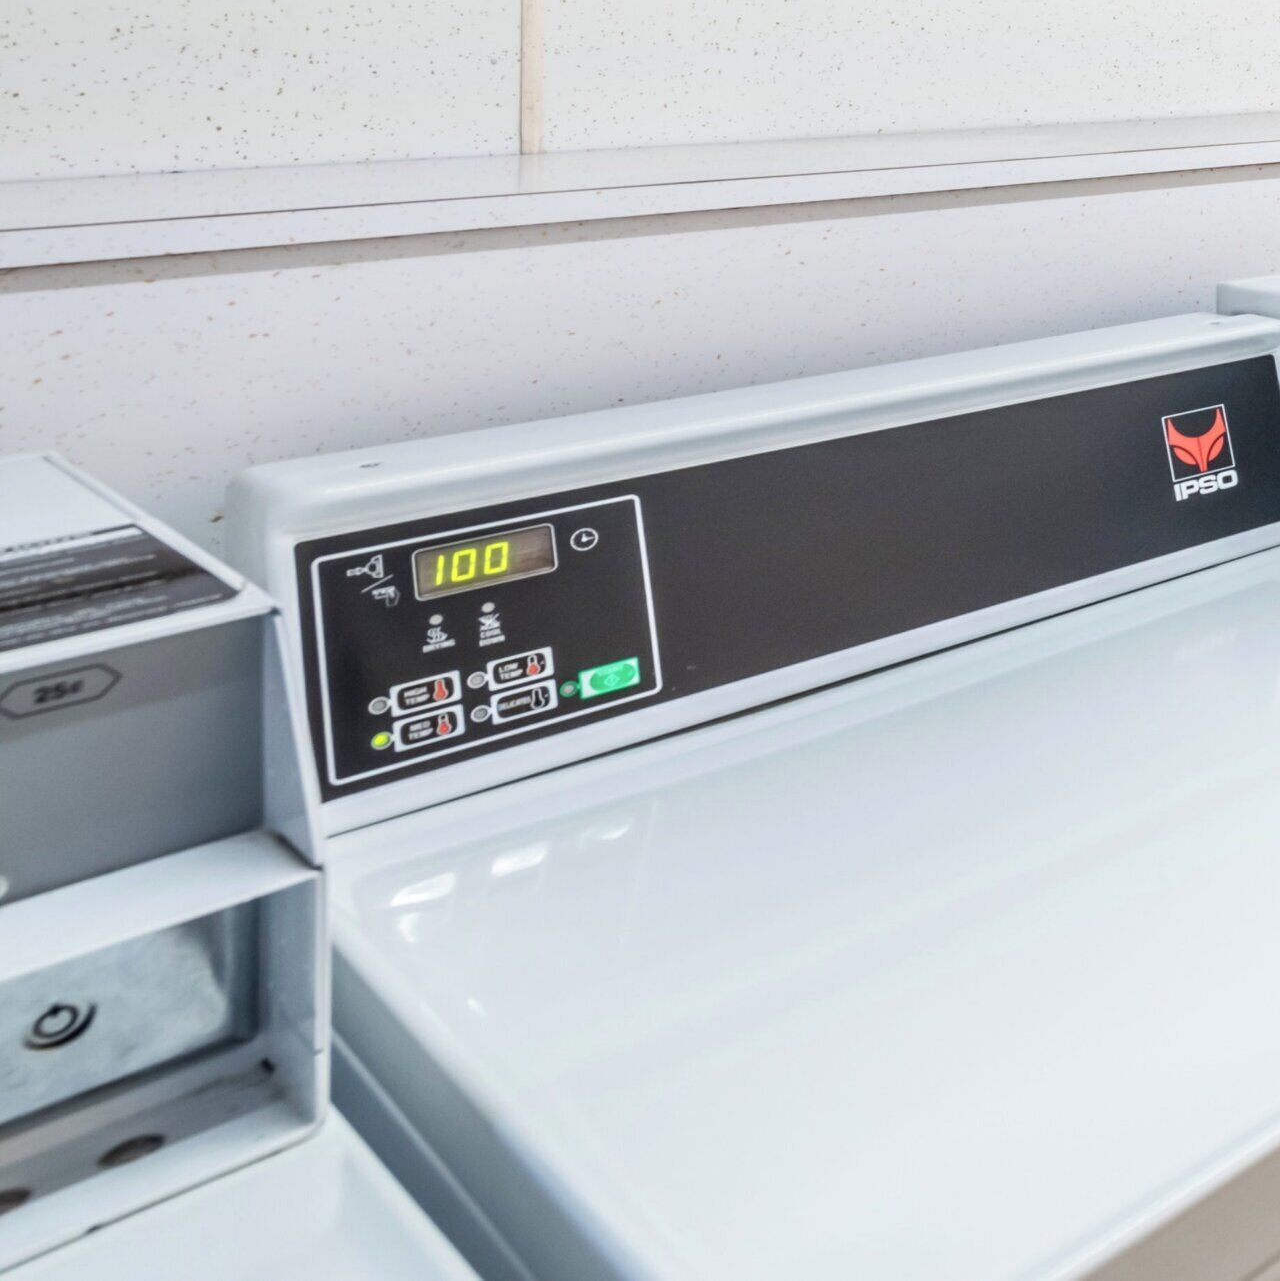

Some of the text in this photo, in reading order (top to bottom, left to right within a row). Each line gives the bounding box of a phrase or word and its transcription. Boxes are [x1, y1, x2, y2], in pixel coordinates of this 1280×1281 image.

[1173, 469, 1239, 502] IPSO
[435, 541, 509, 586] 100
[500, 669, 524, 680] TEMP
[404, 693, 431, 706] TEMP
[408, 727, 434, 741] TEMP
